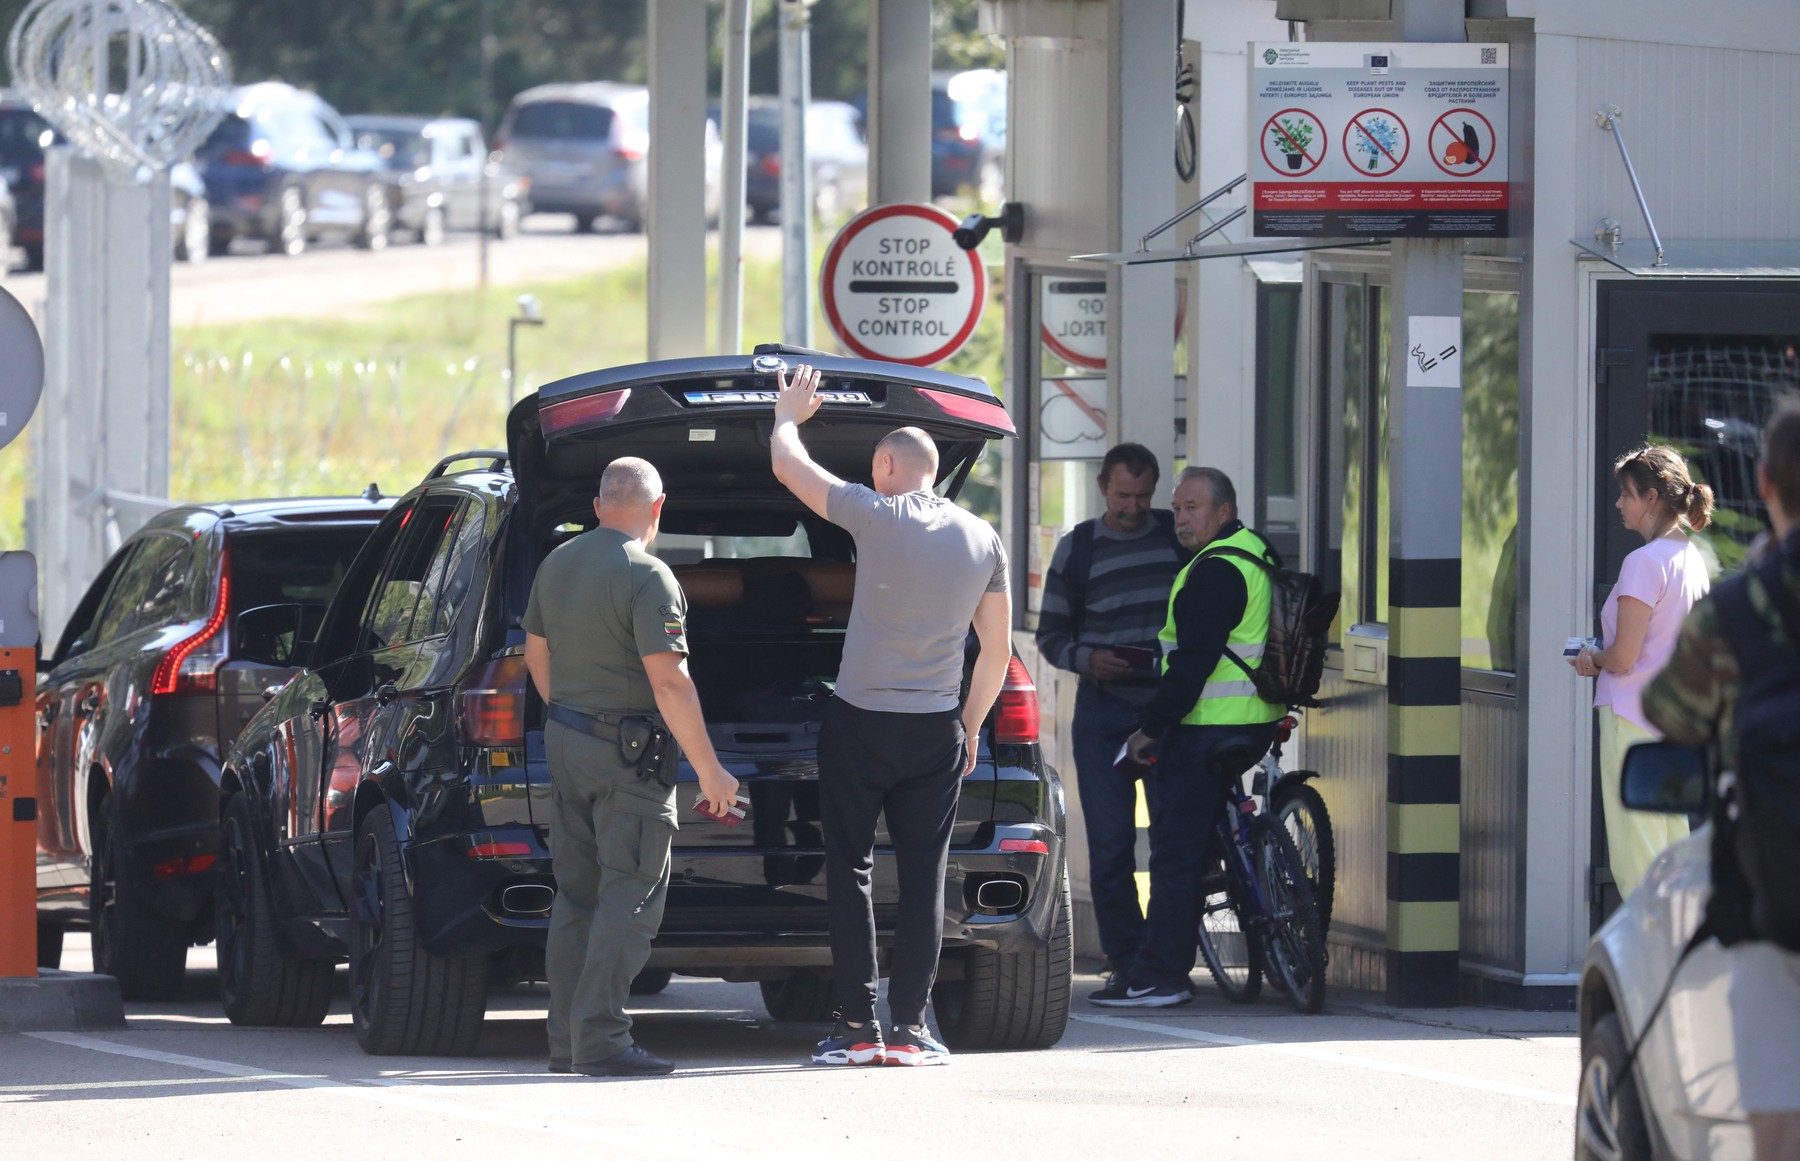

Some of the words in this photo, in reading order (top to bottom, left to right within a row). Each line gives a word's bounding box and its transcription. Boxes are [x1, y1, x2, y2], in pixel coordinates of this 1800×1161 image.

[879, 238, 930, 254] STOP
[853, 256, 955, 276] KONTROLĖ
[879, 298, 929, 314] STOP
[858, 319, 949, 336] CONTROL
